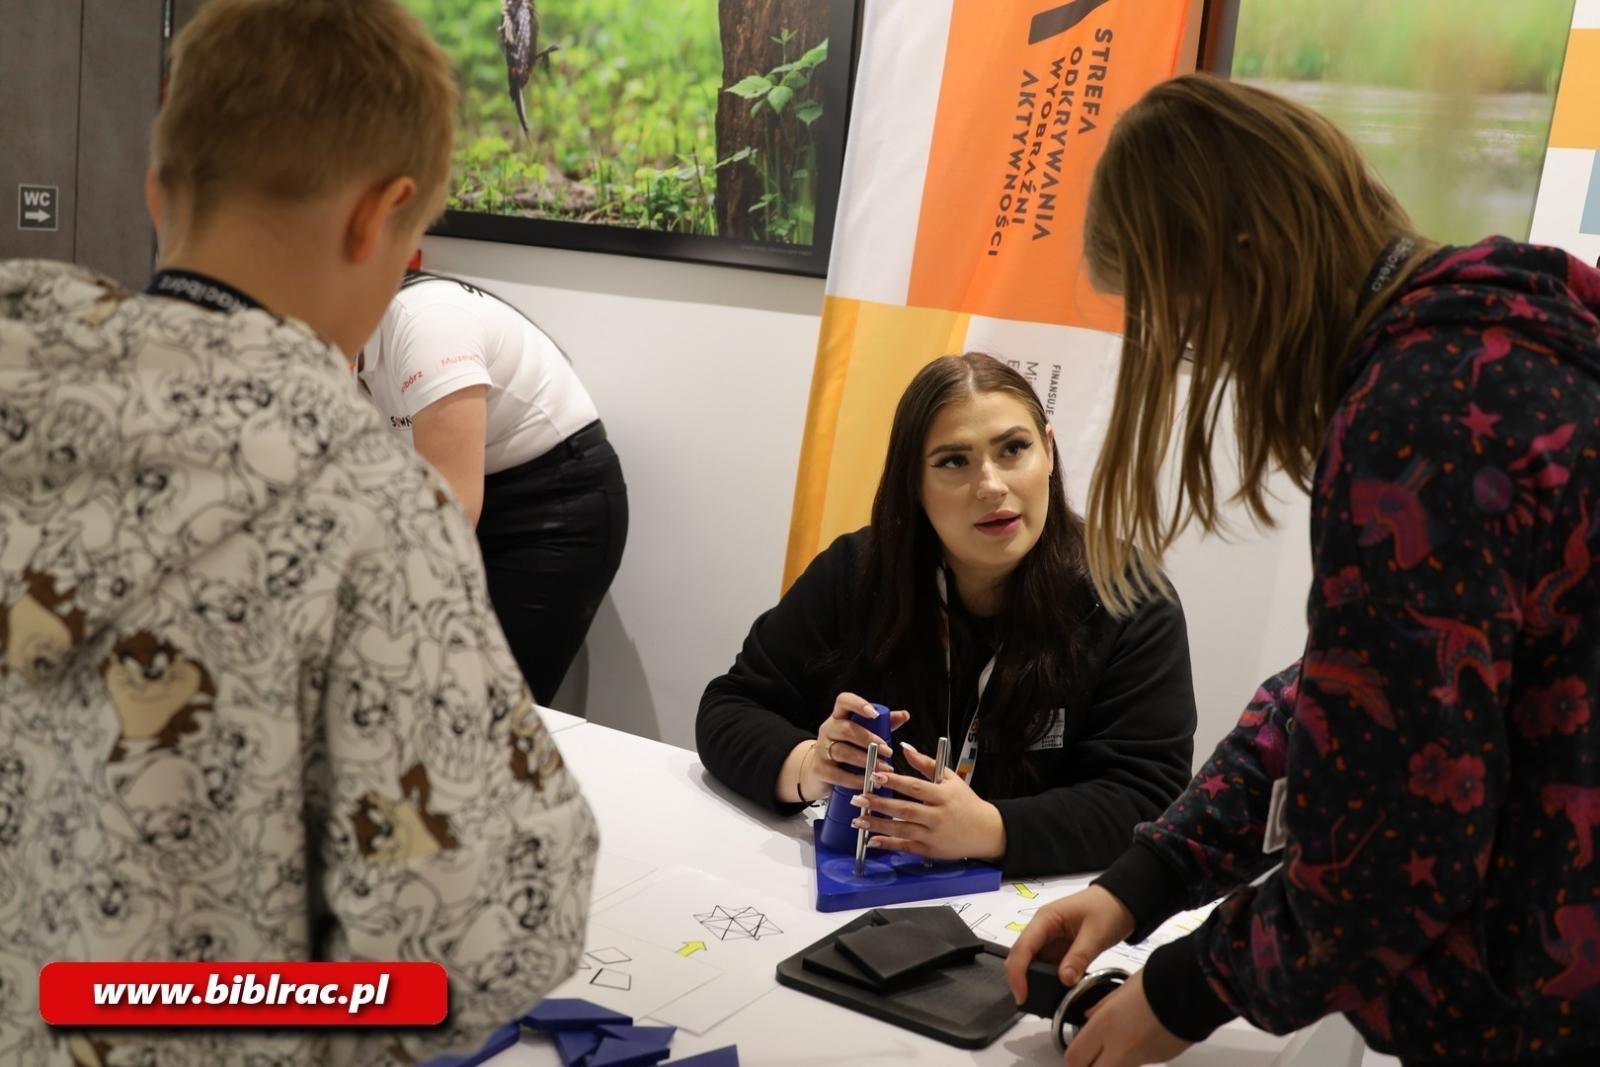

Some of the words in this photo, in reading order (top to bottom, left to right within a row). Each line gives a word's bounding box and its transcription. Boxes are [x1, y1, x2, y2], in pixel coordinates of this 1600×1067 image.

[1012, 56, 1066, 225] WYOBRAŹNI
[1032, 46, 1083, 241] ODKRYWANIA
[1078, 27, 1113, 135] STREFA
[24, 191, 51, 207] WC
[988, 69, 1040, 256] AKTYWNOŚCI
[1045, 364, 1062, 416] FINANSUJE
